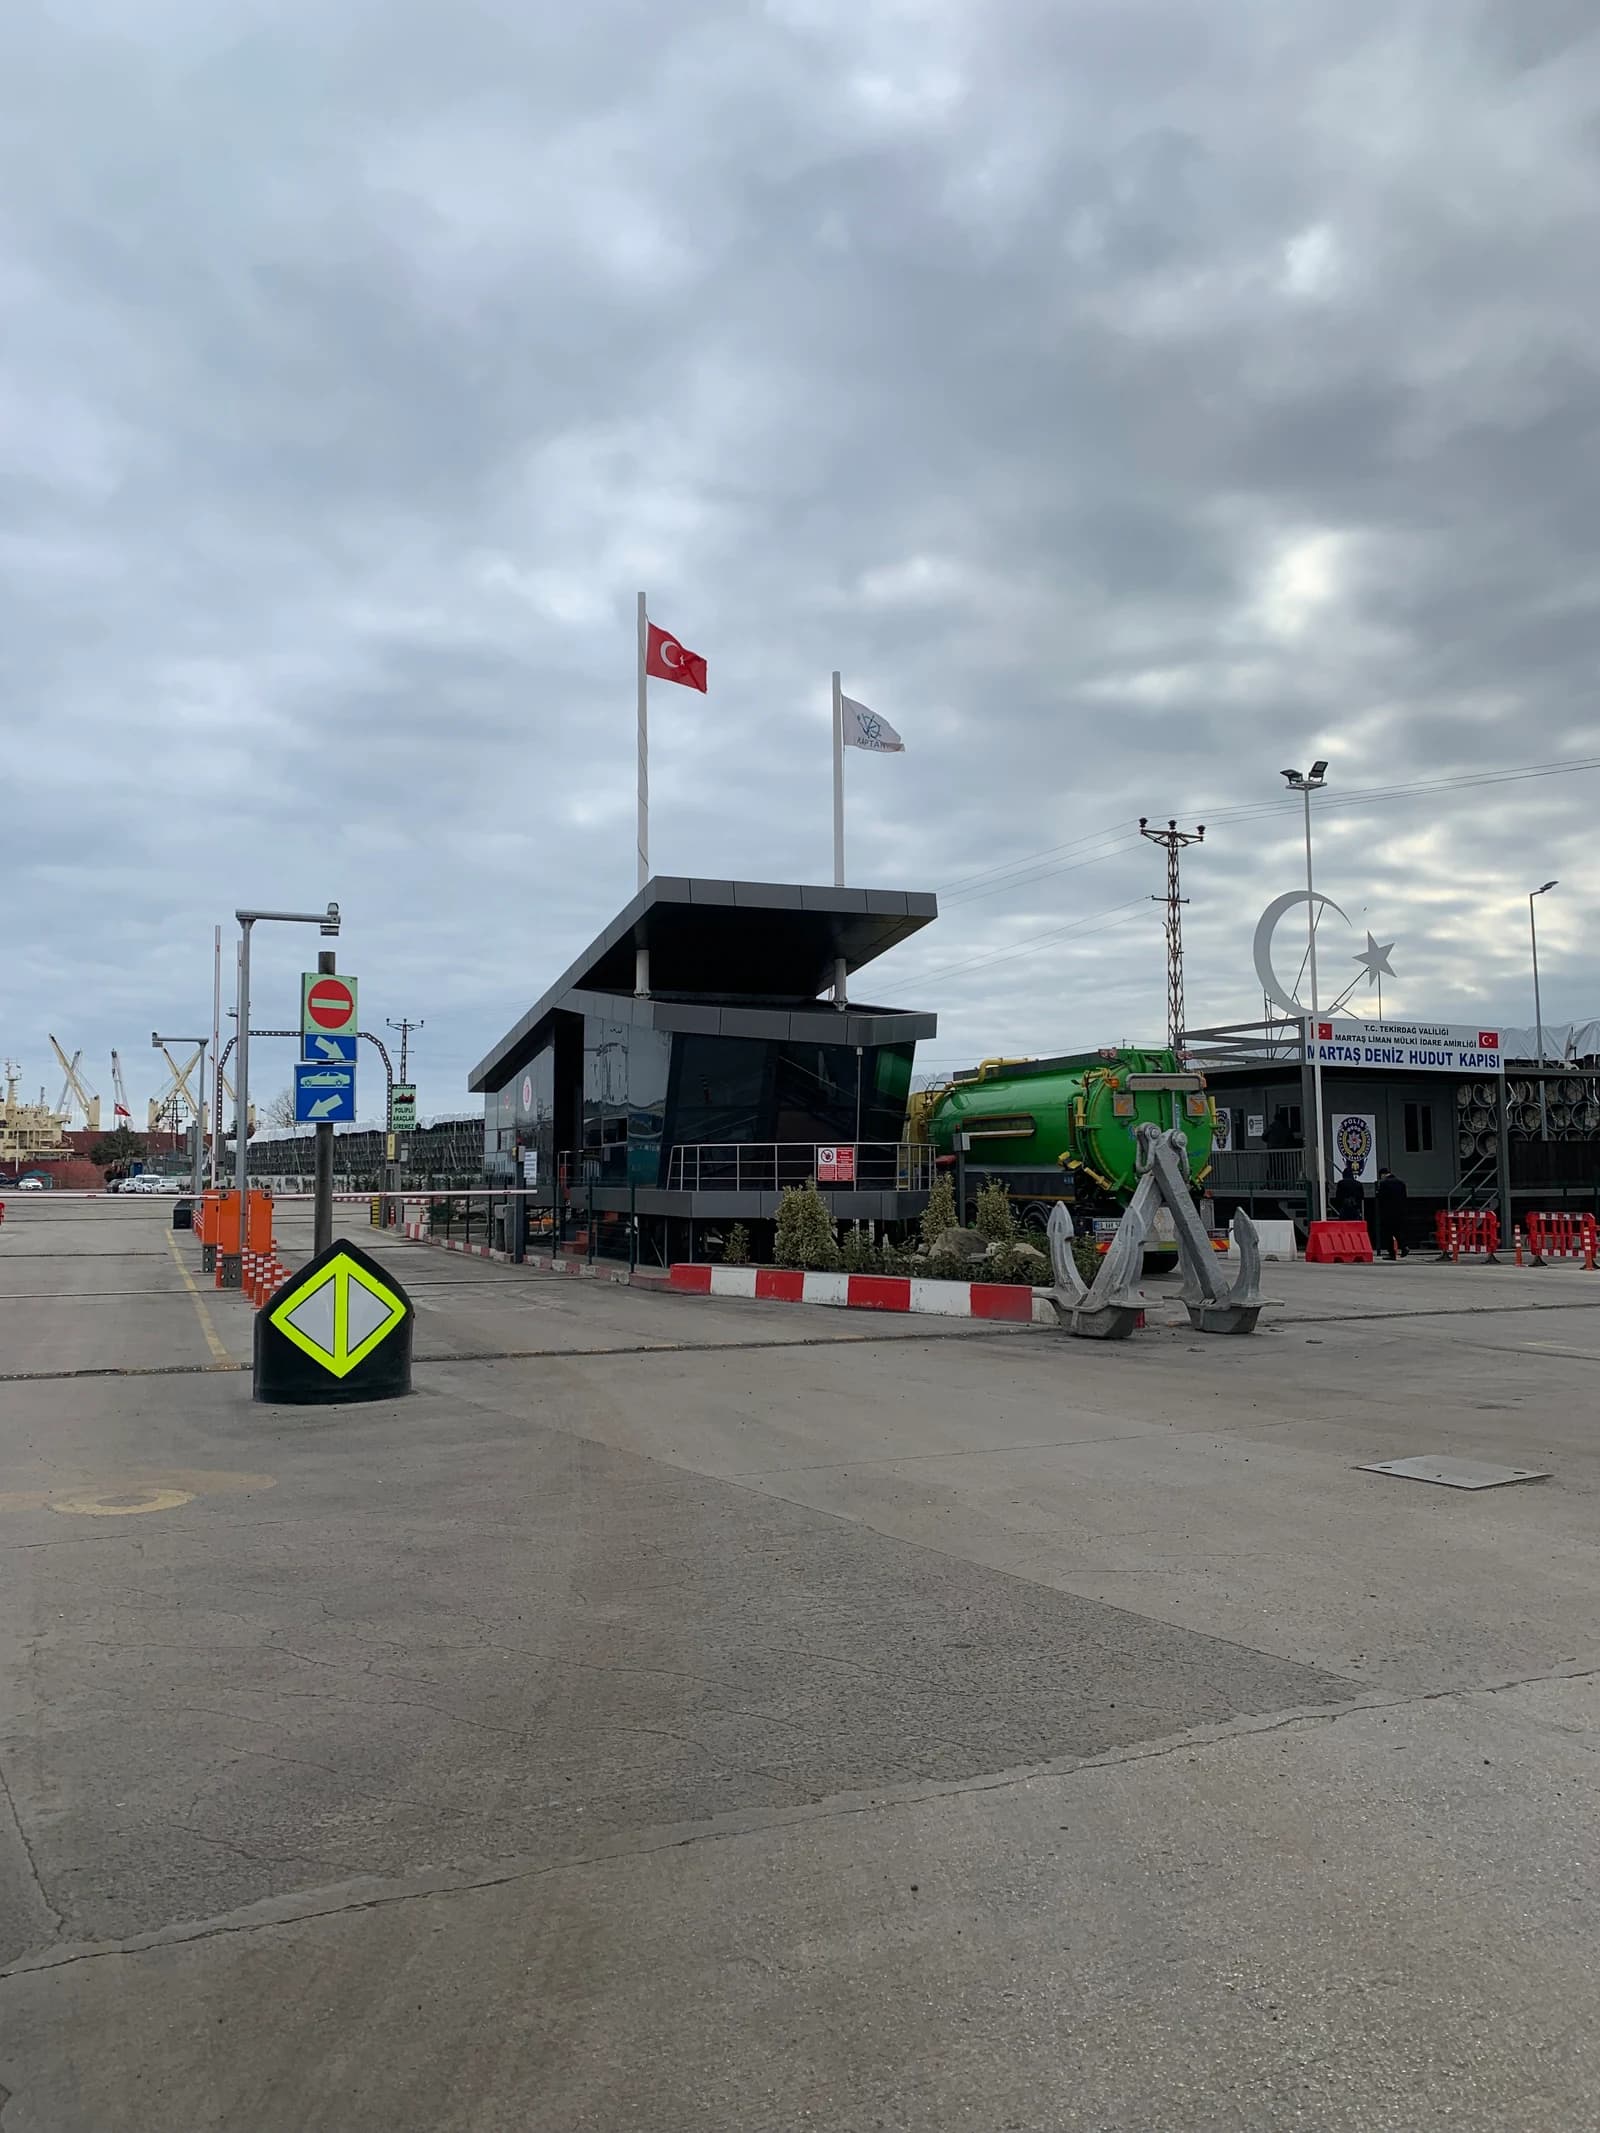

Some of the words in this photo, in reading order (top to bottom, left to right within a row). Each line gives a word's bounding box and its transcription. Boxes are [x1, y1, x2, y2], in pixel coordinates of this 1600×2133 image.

[1364, 1024, 1378, 1032] T.C.
[1379, 1025, 1417, 1034] TEKİRDAĞ
[1419, 1027, 1449, 1036] VALİLİĞİ
[1334, 1034, 1366, 1043] MARTAŞ
[1368, 1035, 1392, 1044] LİMAN
[1419, 1038, 1442, 1047] İDARE
[1365, 1047, 1404, 1063] DENİZ
[1409, 1050, 1453, 1066] HUDUT
[1459, 1053, 1500, 1068] KAPISI
